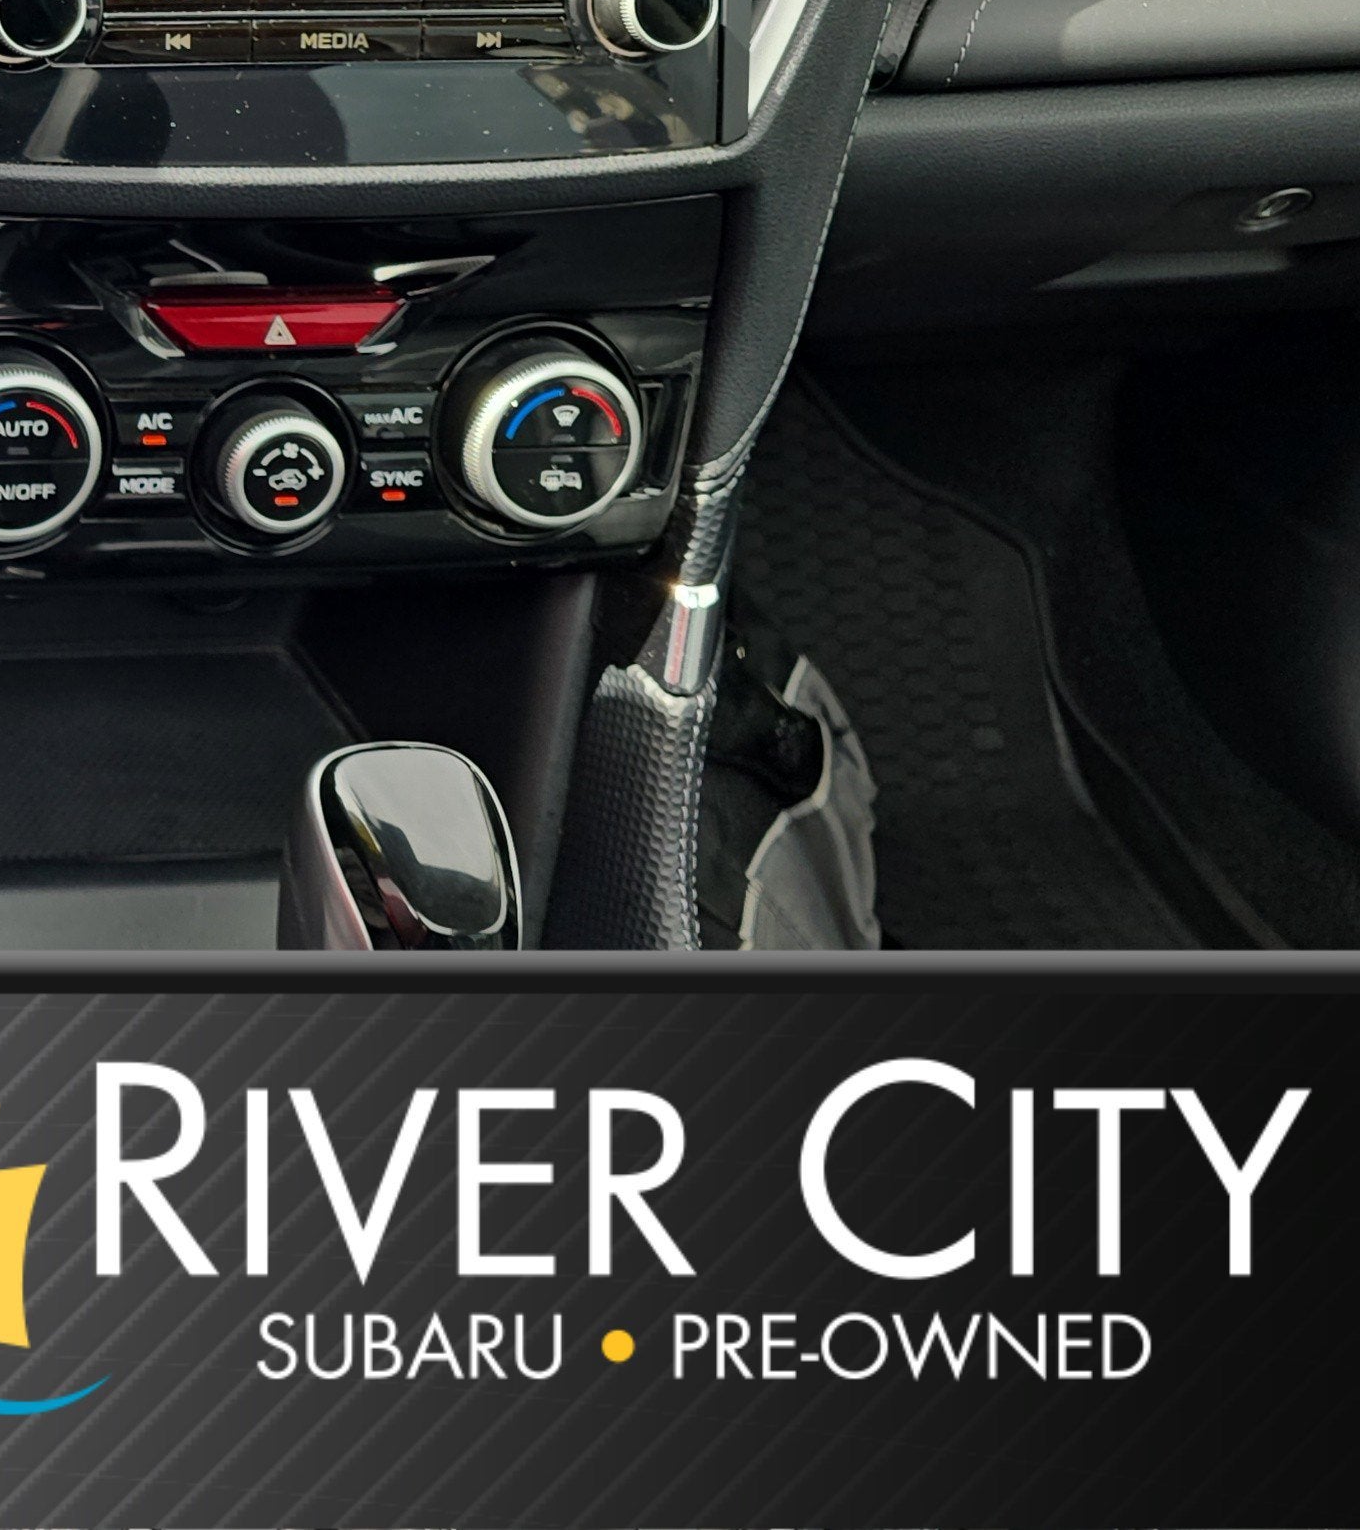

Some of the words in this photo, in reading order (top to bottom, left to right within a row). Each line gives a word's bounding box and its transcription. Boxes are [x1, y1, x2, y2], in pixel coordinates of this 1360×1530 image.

[299, 32, 368, 51] MEDIA
[137, 413, 172, 432] A/C
[119, 477, 175, 496] MODE
[370, 469, 424, 488] SYNC
